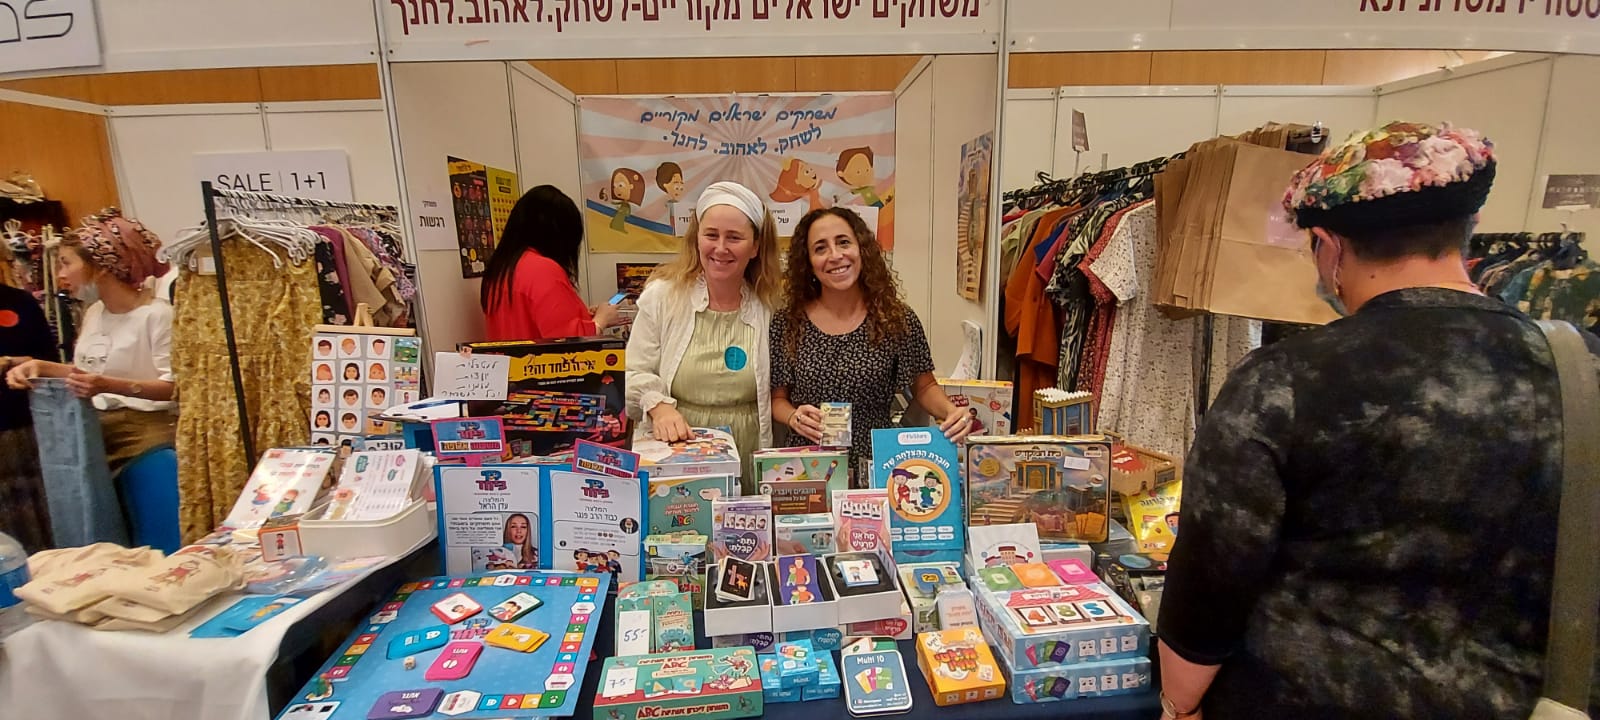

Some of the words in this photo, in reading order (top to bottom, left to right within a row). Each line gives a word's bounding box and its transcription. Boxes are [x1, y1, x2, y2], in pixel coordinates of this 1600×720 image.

[640, 109, 700, 131] מקוריים
[708, 102, 767, 123] ישראלים
[775, 106, 838, 129] משחקים
[663, 130, 708, 151] לחנך.
[713, 137, 767, 156] לאהוב.
[774, 123, 822, 155] לשחק.
[217, 173, 273, 192] SALE
[290, 171, 327, 191] 1+1
[419, 215, 446, 229] רגשות
[475, 480, 508, 491] ביחד
[581, 486, 610, 499] ביחד
[1055, 604, 1077, 617] 8
[1082, 602, 1105, 615] 5
[662, 661, 688, 669] ABC
[856, 656, 875, 664] Multi
[876, 654, 885, 663] 10
[637, 706, 661, 719] ABC
